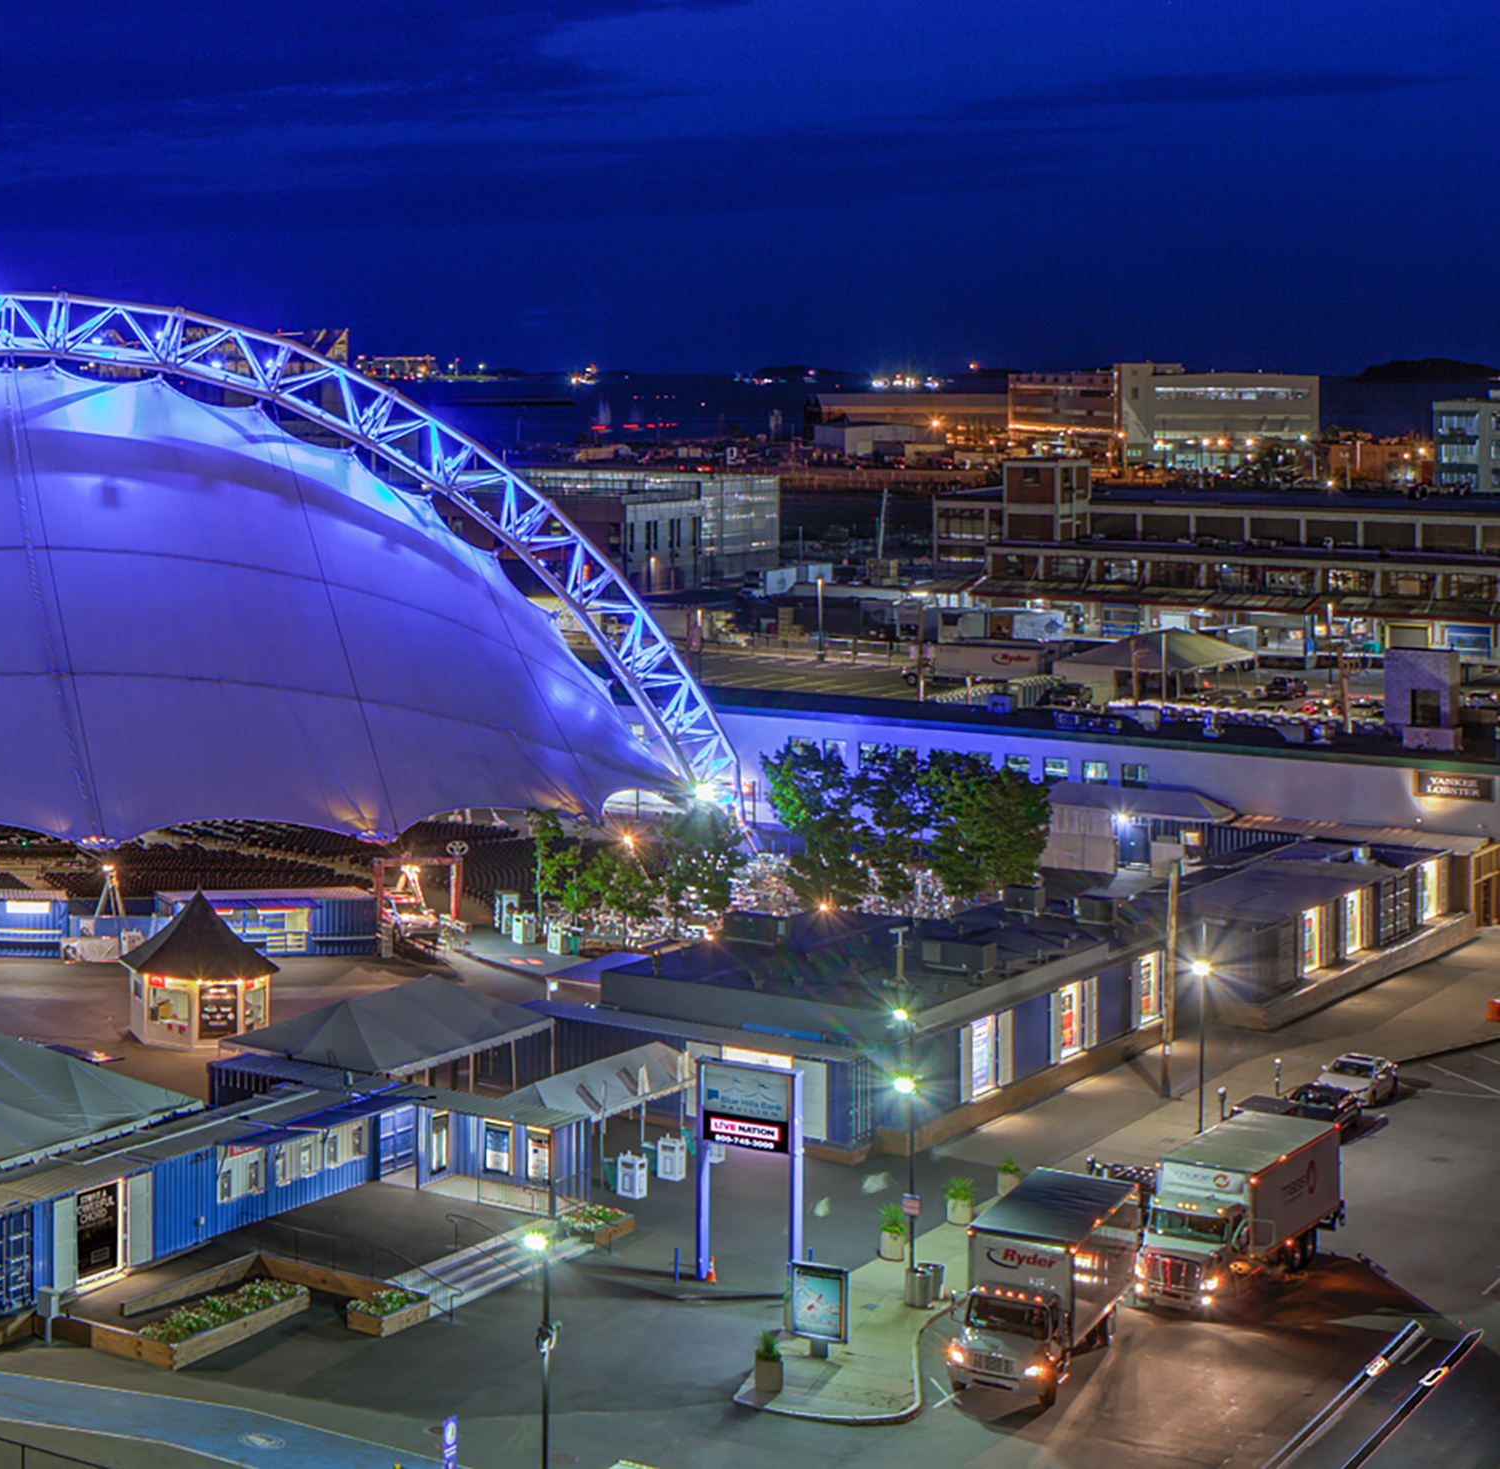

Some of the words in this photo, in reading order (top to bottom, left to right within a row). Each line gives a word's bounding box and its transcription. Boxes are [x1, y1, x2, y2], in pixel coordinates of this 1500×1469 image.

[1001, 654, 1031, 663] Ryder
[1429, 777, 1478, 787] YANKEE
[1426, 785, 1480, 796] LOBSTER
[720, 1095, 739, 1105] Blue
[740, 1099, 759, 1108] Hills
[760, 1101, 782, 1111] Bank
[714, 1121, 736, 1131] LIVE
[738, 1125, 775, 1136] NATION
[1003, 1248, 1057, 1268] Ryder
